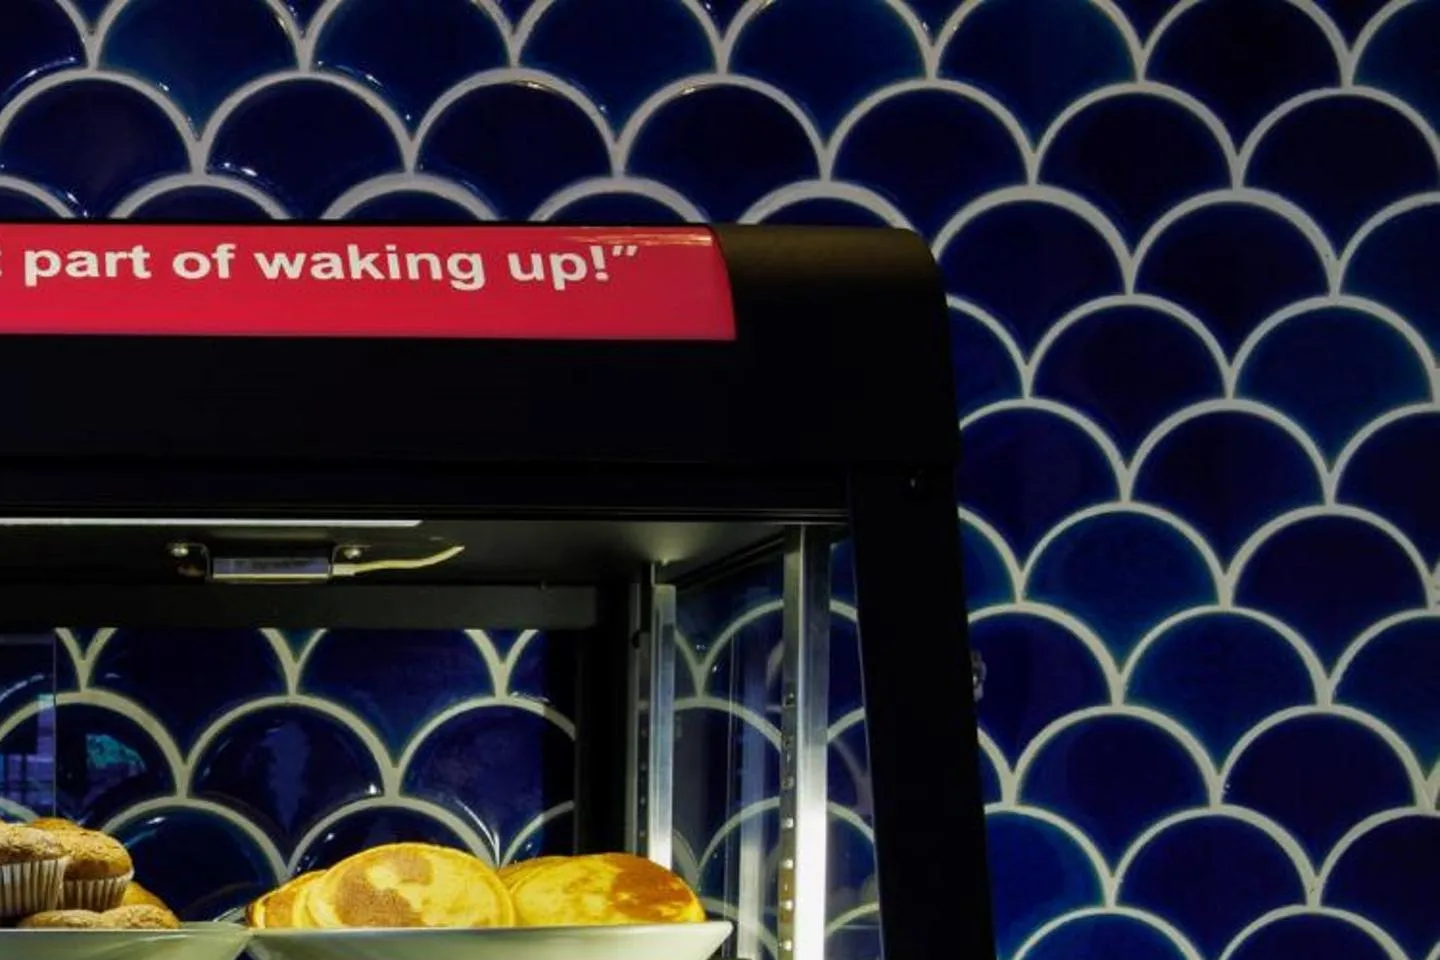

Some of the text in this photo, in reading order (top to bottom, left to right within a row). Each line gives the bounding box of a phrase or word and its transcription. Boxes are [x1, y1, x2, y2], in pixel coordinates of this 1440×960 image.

[24, 245, 152, 287] part
[172, 244, 236, 280] of
[254, 244, 486, 291] waking
